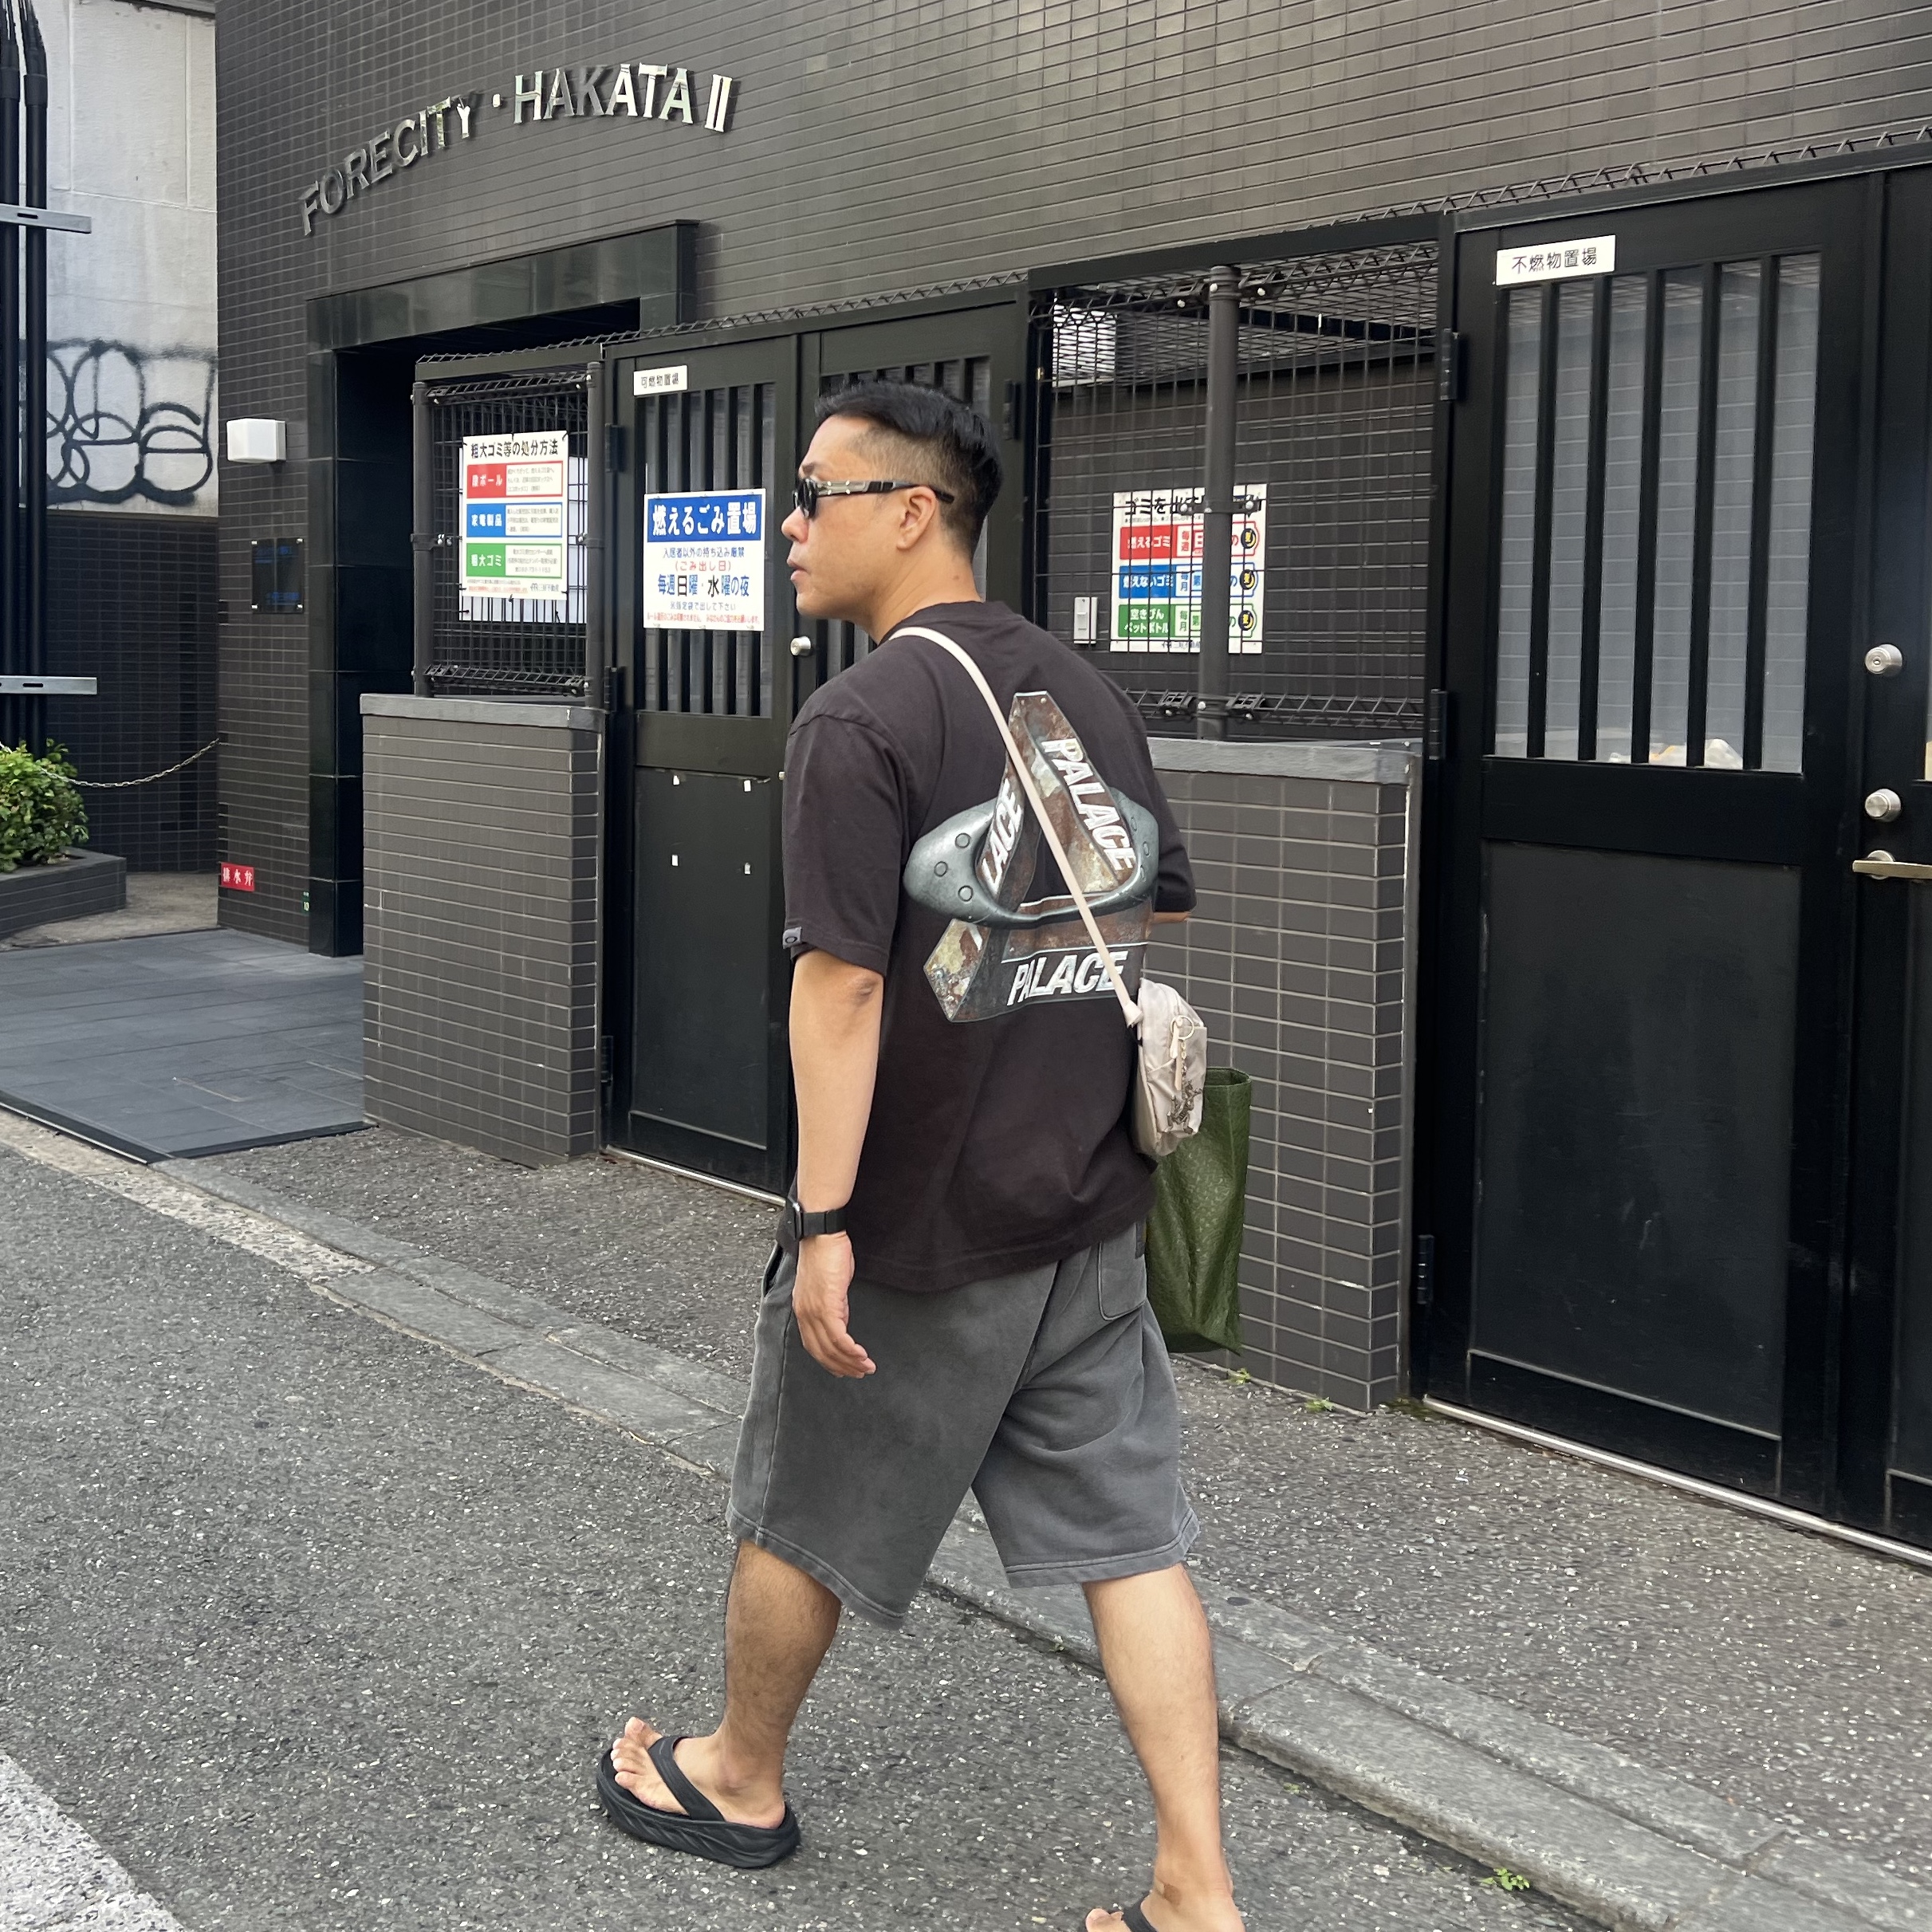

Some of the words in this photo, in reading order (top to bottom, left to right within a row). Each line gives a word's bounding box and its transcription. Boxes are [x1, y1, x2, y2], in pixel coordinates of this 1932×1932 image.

[298, 95, 474, 237] FORECITY
[512, 63, 694, 124] HAKATA
[1511, 246, 1597, 274] 不燃物置場
[470, 438, 558, 459] 粗大ゴミ等の処分方法
[471, 474, 503, 488] 段ボール
[652, 501, 757, 537] 燃えるごみ置場
[470, 553, 502, 567] 粗大ゴミ
[1041, 738, 1137, 872] PALACE
[1006, 950, 1129, 1006] PALACE
